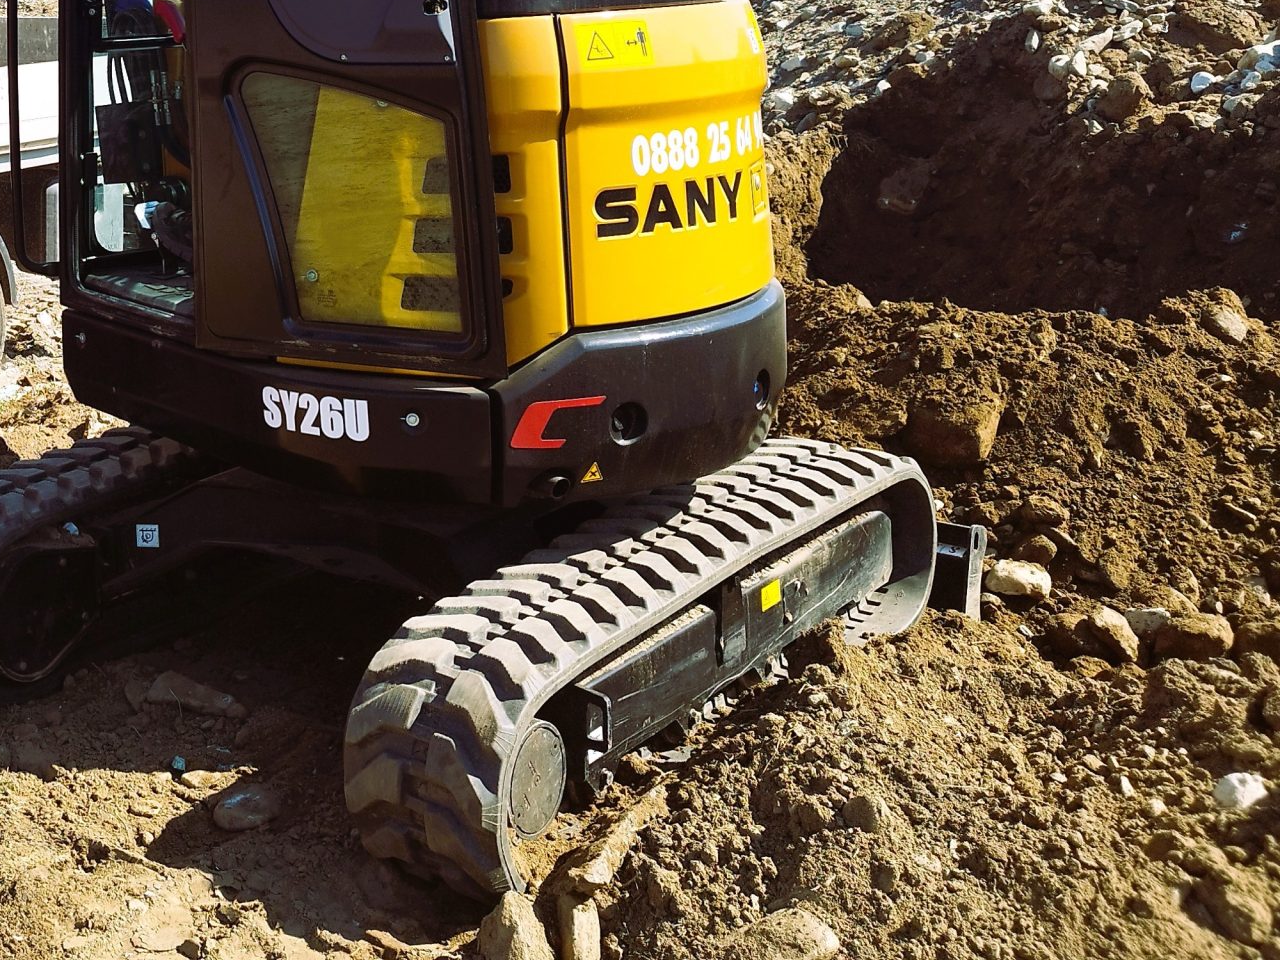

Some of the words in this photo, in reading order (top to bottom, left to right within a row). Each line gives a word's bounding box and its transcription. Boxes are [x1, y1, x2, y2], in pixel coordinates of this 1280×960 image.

[631, 126, 700, 176] 0888
[706, 121, 731, 164] 25
[736, 114, 753, 156] 64
[594, 171, 743, 238] SANY
[262, 386, 370, 442] SY26U
